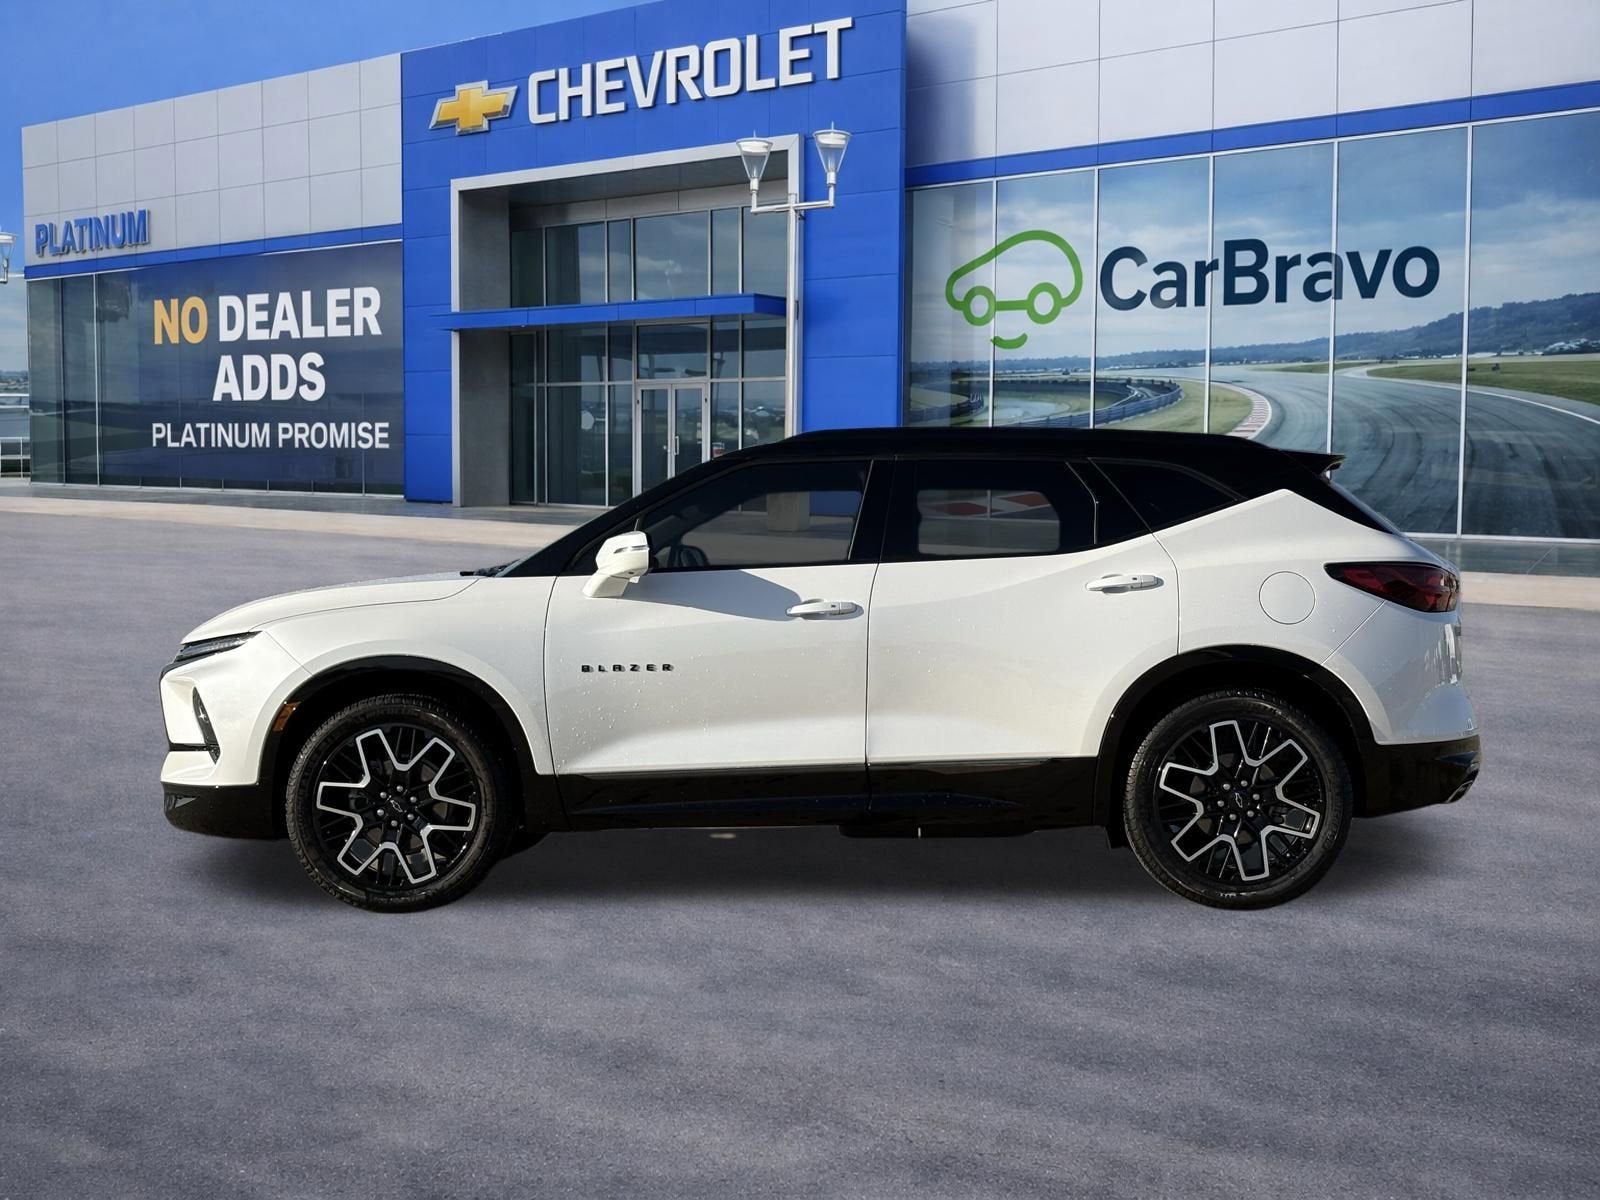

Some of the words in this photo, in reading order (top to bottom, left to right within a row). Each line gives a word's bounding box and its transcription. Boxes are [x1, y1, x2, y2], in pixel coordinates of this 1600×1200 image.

[528, 17, 852, 124] CHEVROLET
[35, 208, 149, 257] PLATINUM
[1100, 239, 1440, 311] CarBravo
[154, 296, 208, 344] NO
[219, 286, 382, 342] DEALER
[213, 352, 326, 401] ADDS
[152, 423, 270, 448] PLATINUM
[278, 422, 389, 449] PROMISE
[581, 663, 674, 673] BLAZER
